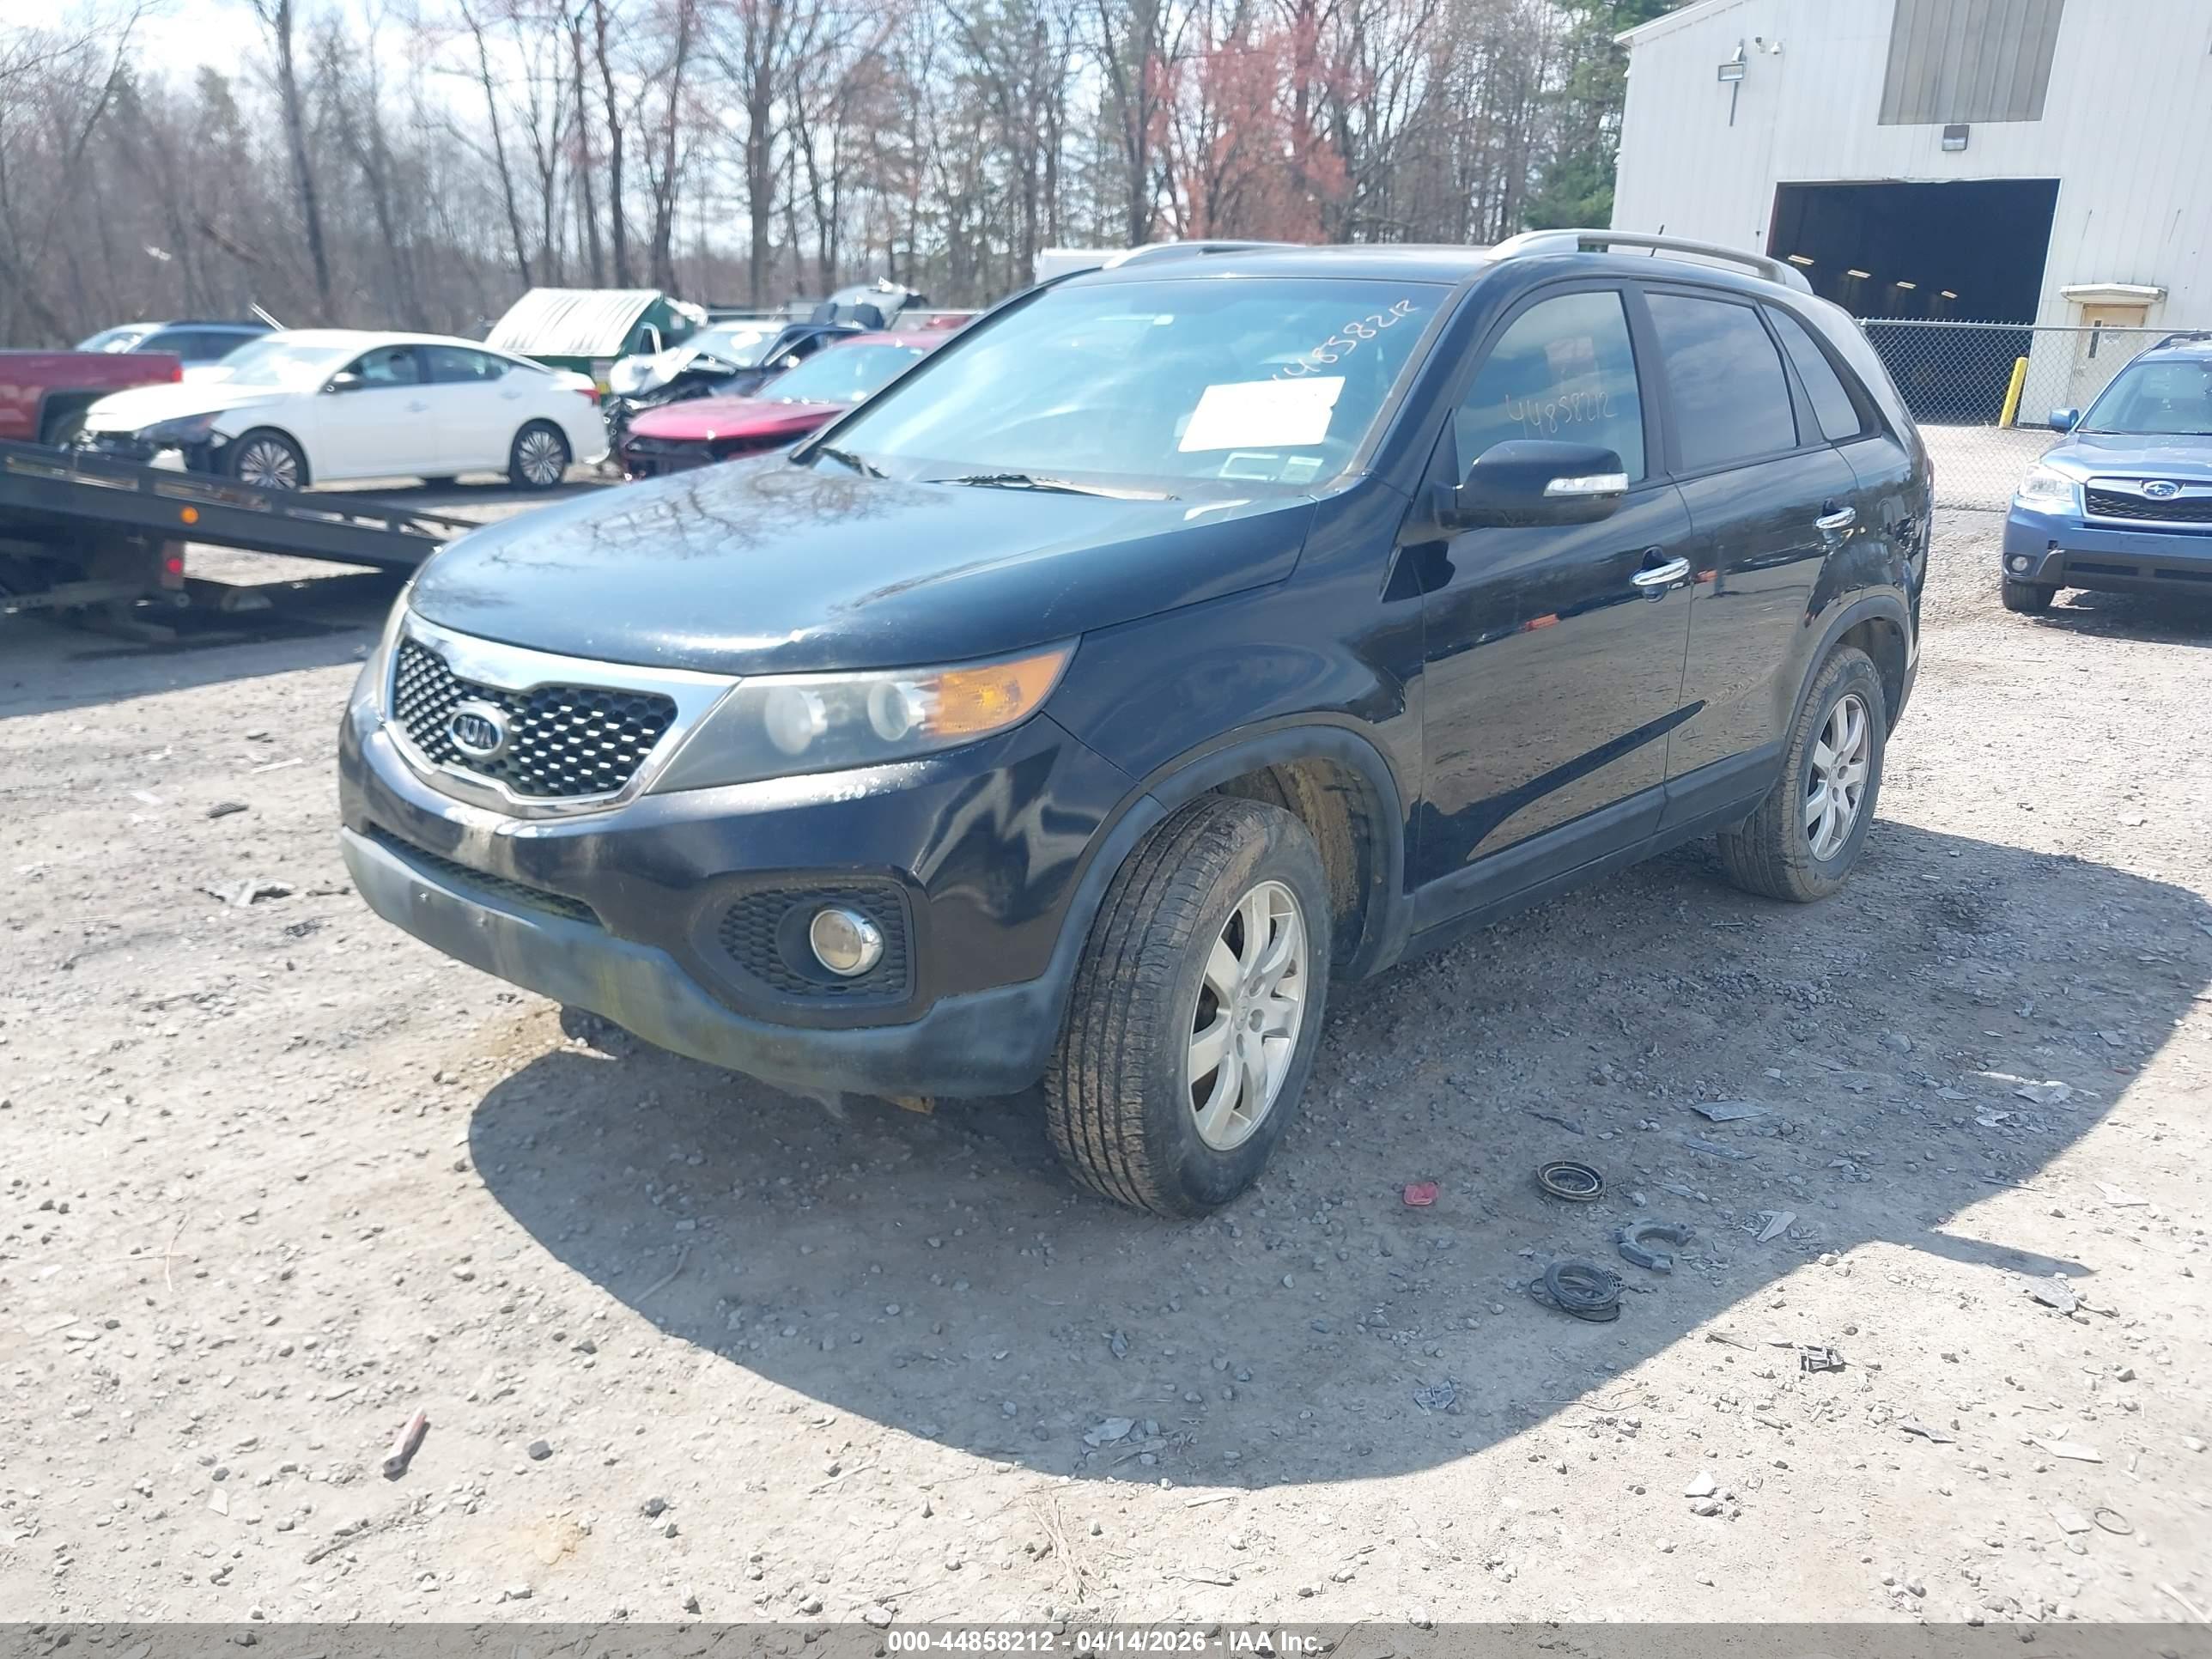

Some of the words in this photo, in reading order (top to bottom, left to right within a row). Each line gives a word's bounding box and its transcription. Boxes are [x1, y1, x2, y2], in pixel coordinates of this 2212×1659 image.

[1272, 297, 1421, 381] 4858212
[1505, 391, 1618, 441] 44858212
[459, 714, 494, 749] KIA
